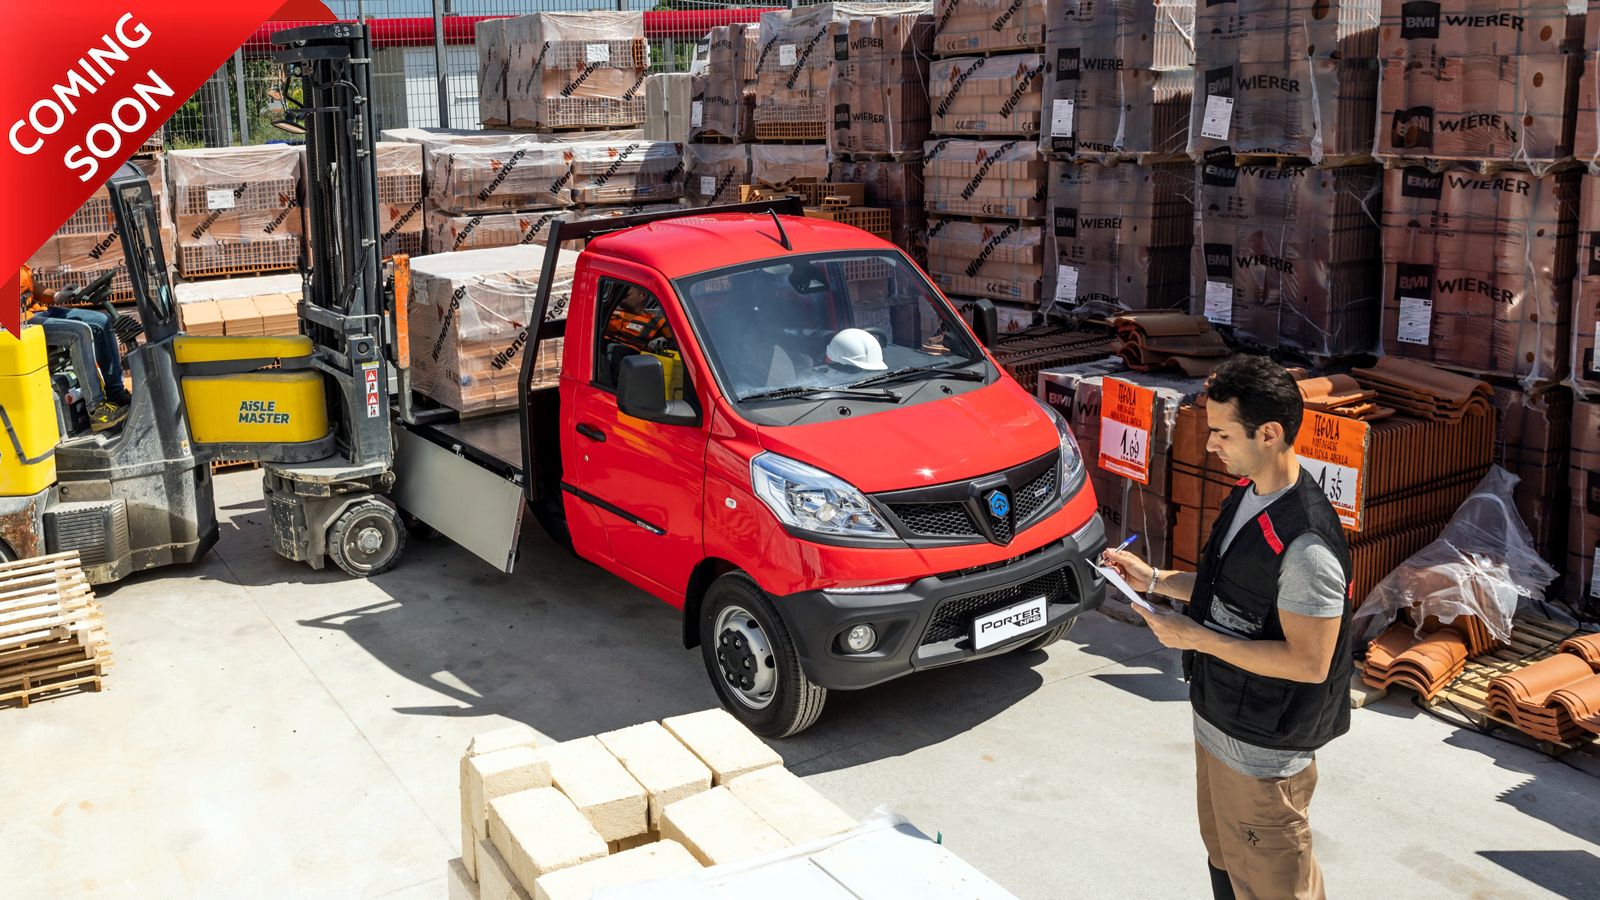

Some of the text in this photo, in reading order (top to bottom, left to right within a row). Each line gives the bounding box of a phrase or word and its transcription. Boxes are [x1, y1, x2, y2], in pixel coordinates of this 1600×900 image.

[1405, 13, 1525, 32] BMI WIERER
[850, 37, 884, 51] WIERER
[1058, 58, 1078, 72] BMI
[1207, 74, 1300, 94] BMI WIERER
[851, 111, 885, 124] WIERER
[1205, 164, 1236, 179] BMI
[1407, 174, 1531, 197] BMI WIERER
[1056, 217, 1075, 228] BMI
[1207, 254, 1229, 267] BMI
[1399, 275, 1514, 305] BMI WIERER
[1048, 392, 1072, 408] BMI
[238, 413, 290, 424] MASTER
[1314, 414, 1340, 440] TEGOLA
[981, 606, 1041, 633] PORTER
